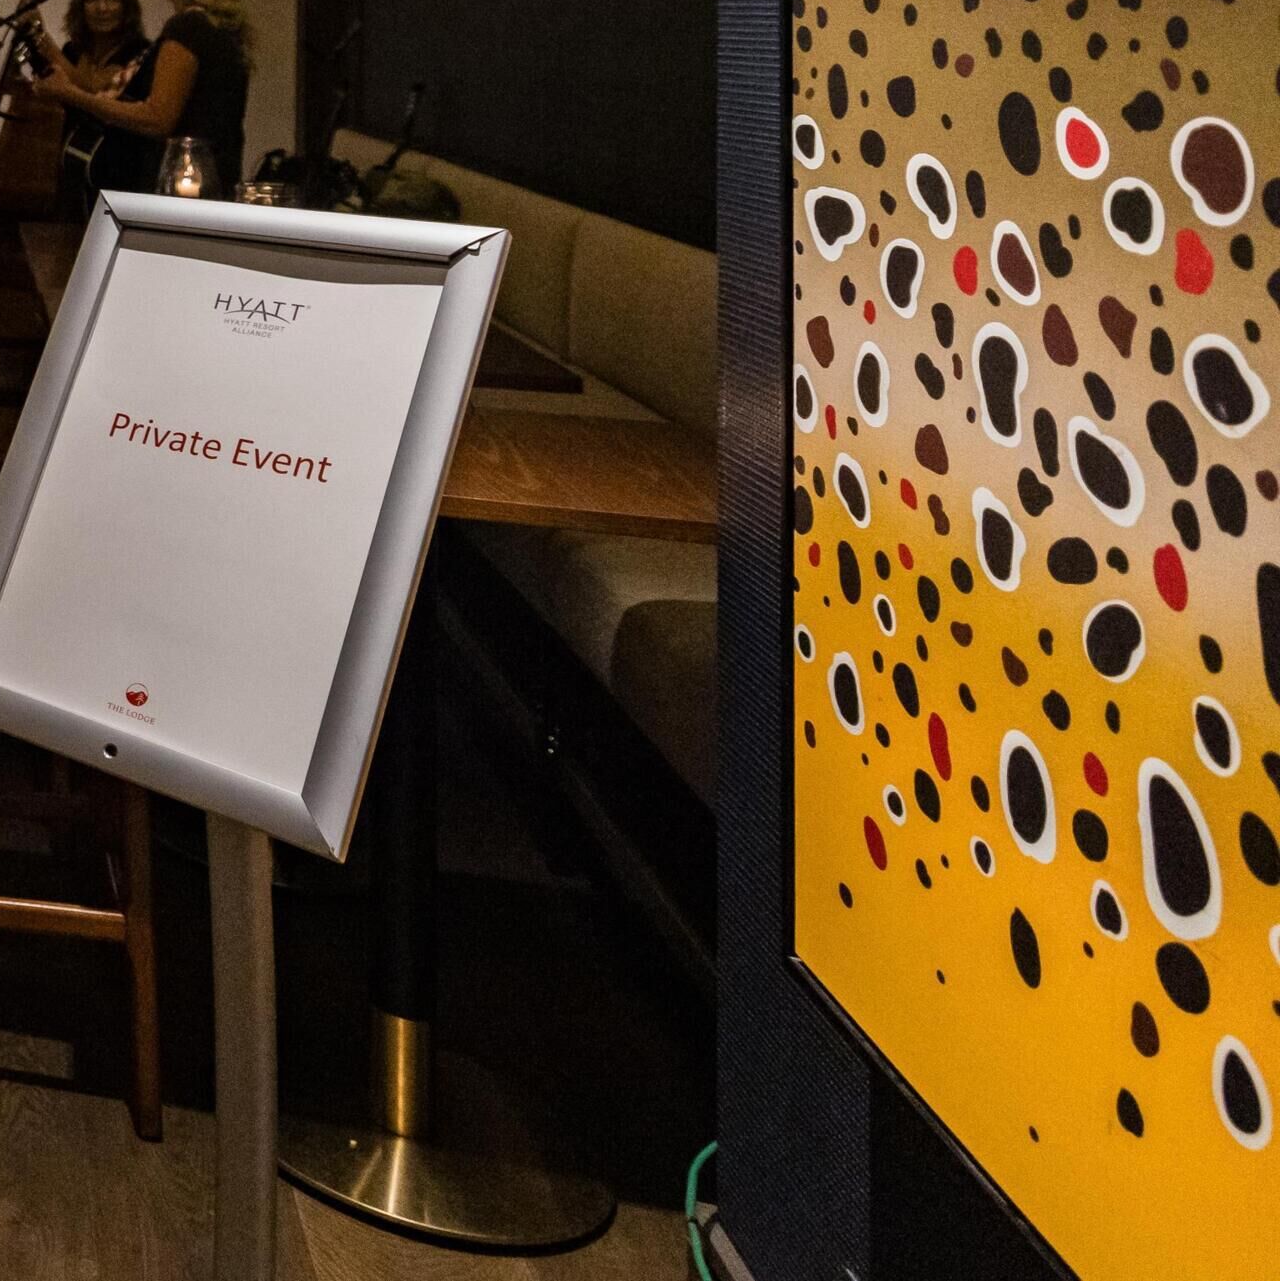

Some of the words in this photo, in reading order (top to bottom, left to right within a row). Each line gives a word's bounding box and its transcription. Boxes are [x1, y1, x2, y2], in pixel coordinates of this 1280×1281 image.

[213, 293, 306, 323] HYATT
[231, 326, 273, 339] ALLIANCE
[252, 321, 286, 333] RESORT
[108, 412, 222, 461] Private
[231, 437, 333, 484] Event
[107, 702, 125, 714] THE
[126, 709, 156, 725] LODGE
